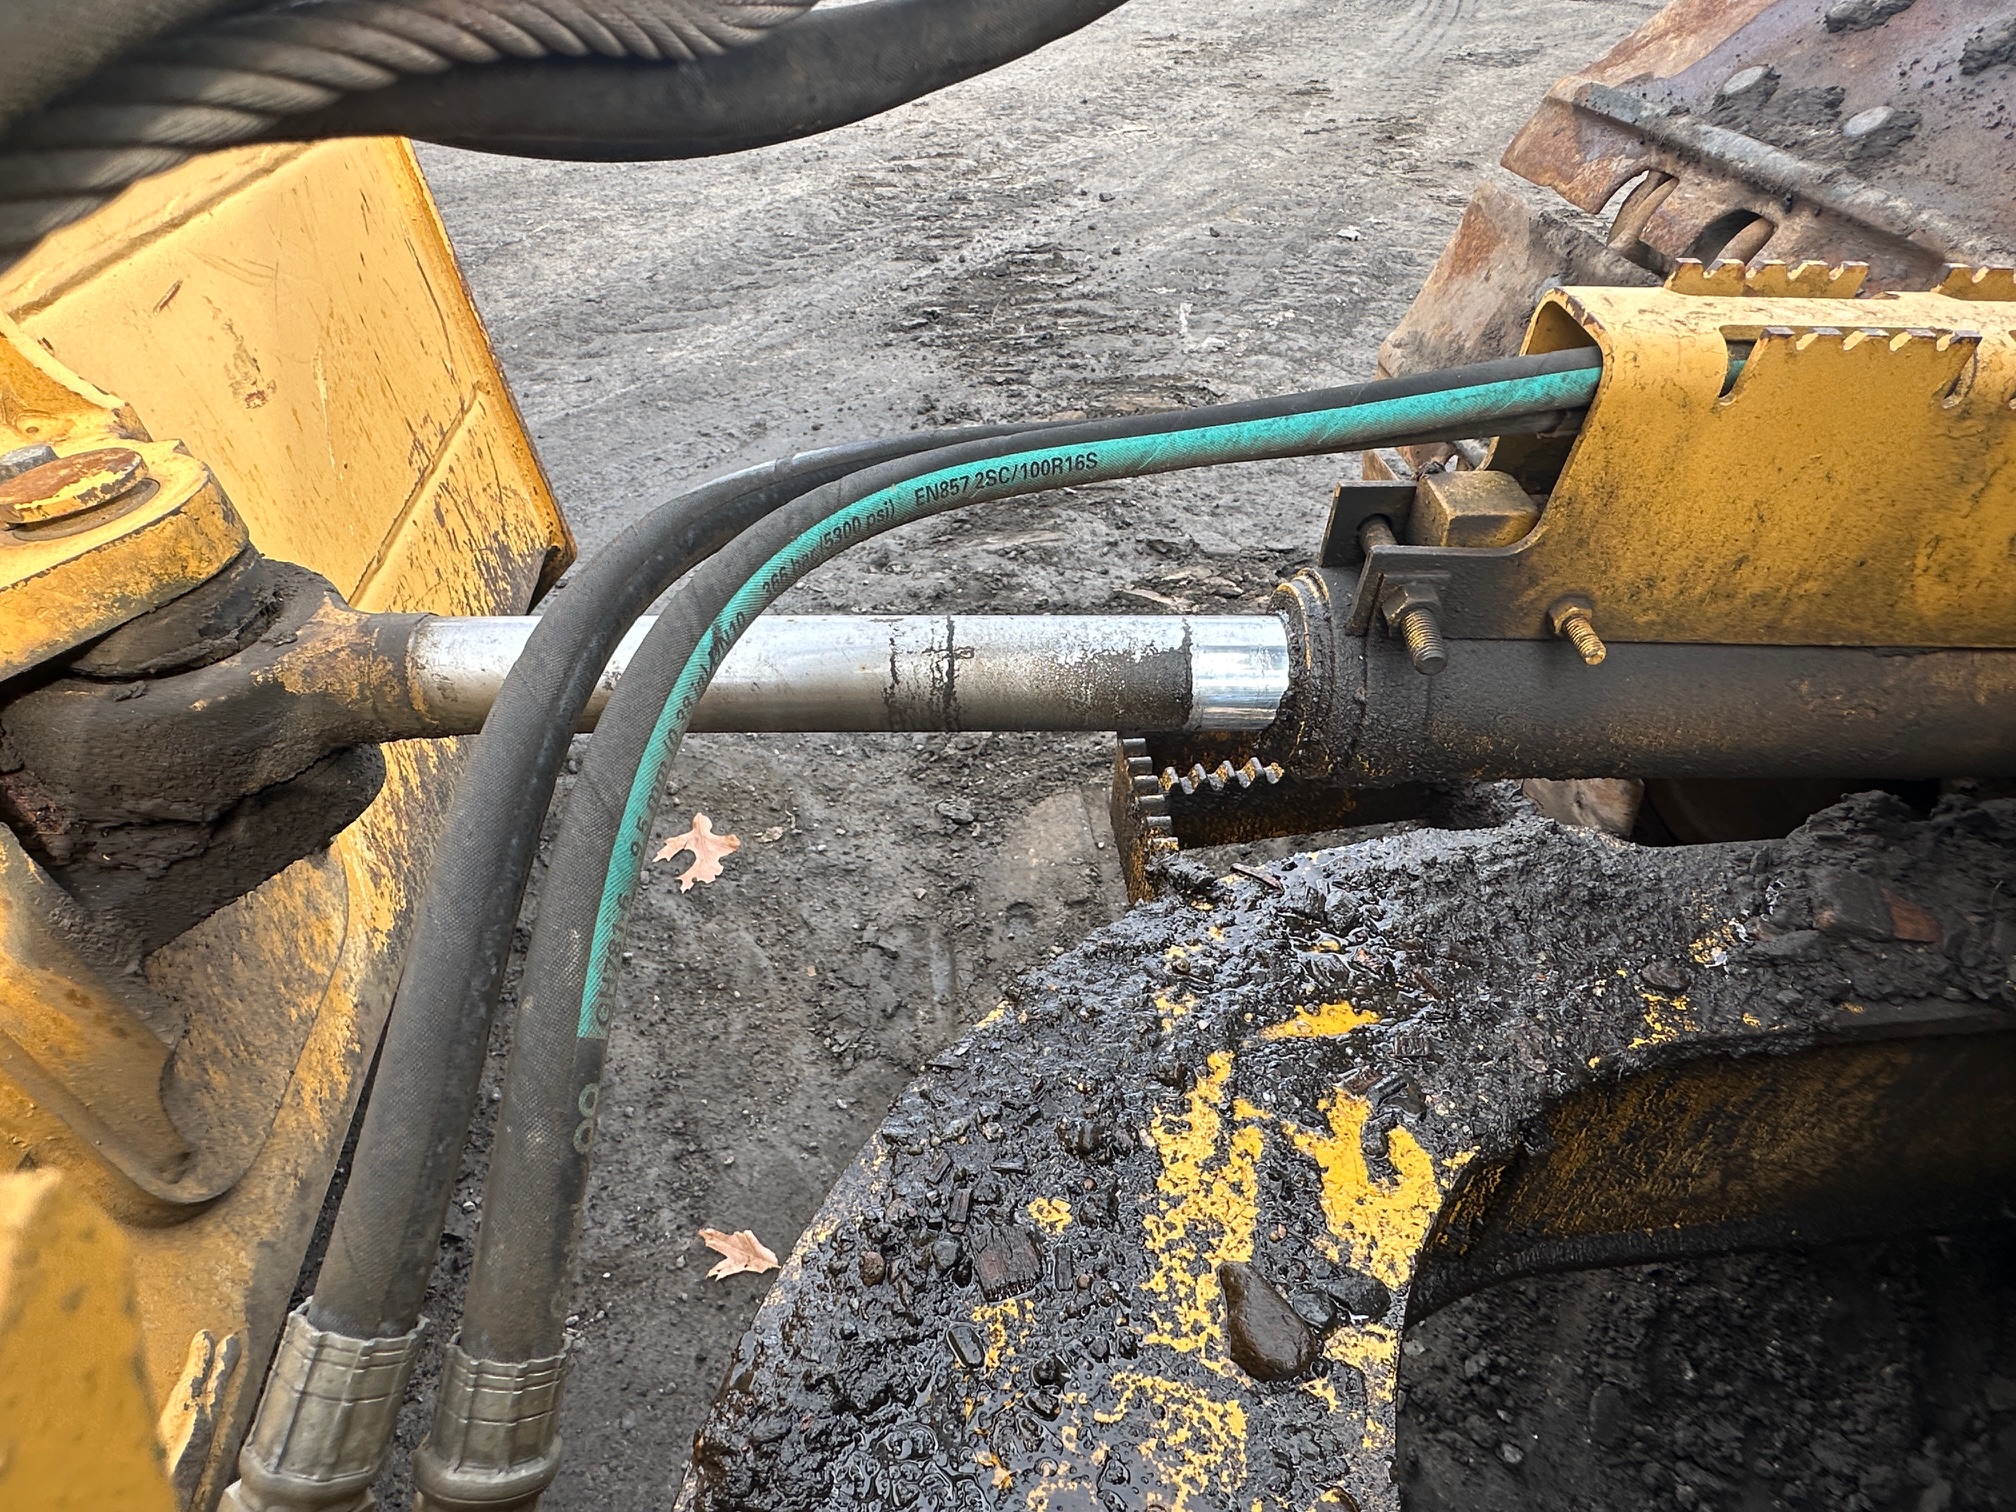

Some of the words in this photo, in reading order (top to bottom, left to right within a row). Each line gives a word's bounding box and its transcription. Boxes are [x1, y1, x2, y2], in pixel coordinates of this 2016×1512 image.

[866, 498, 895, 530] psi)
[914, 476, 970, 507] EN857
[974, 452, 1098, 490] 2SC/100R16S
